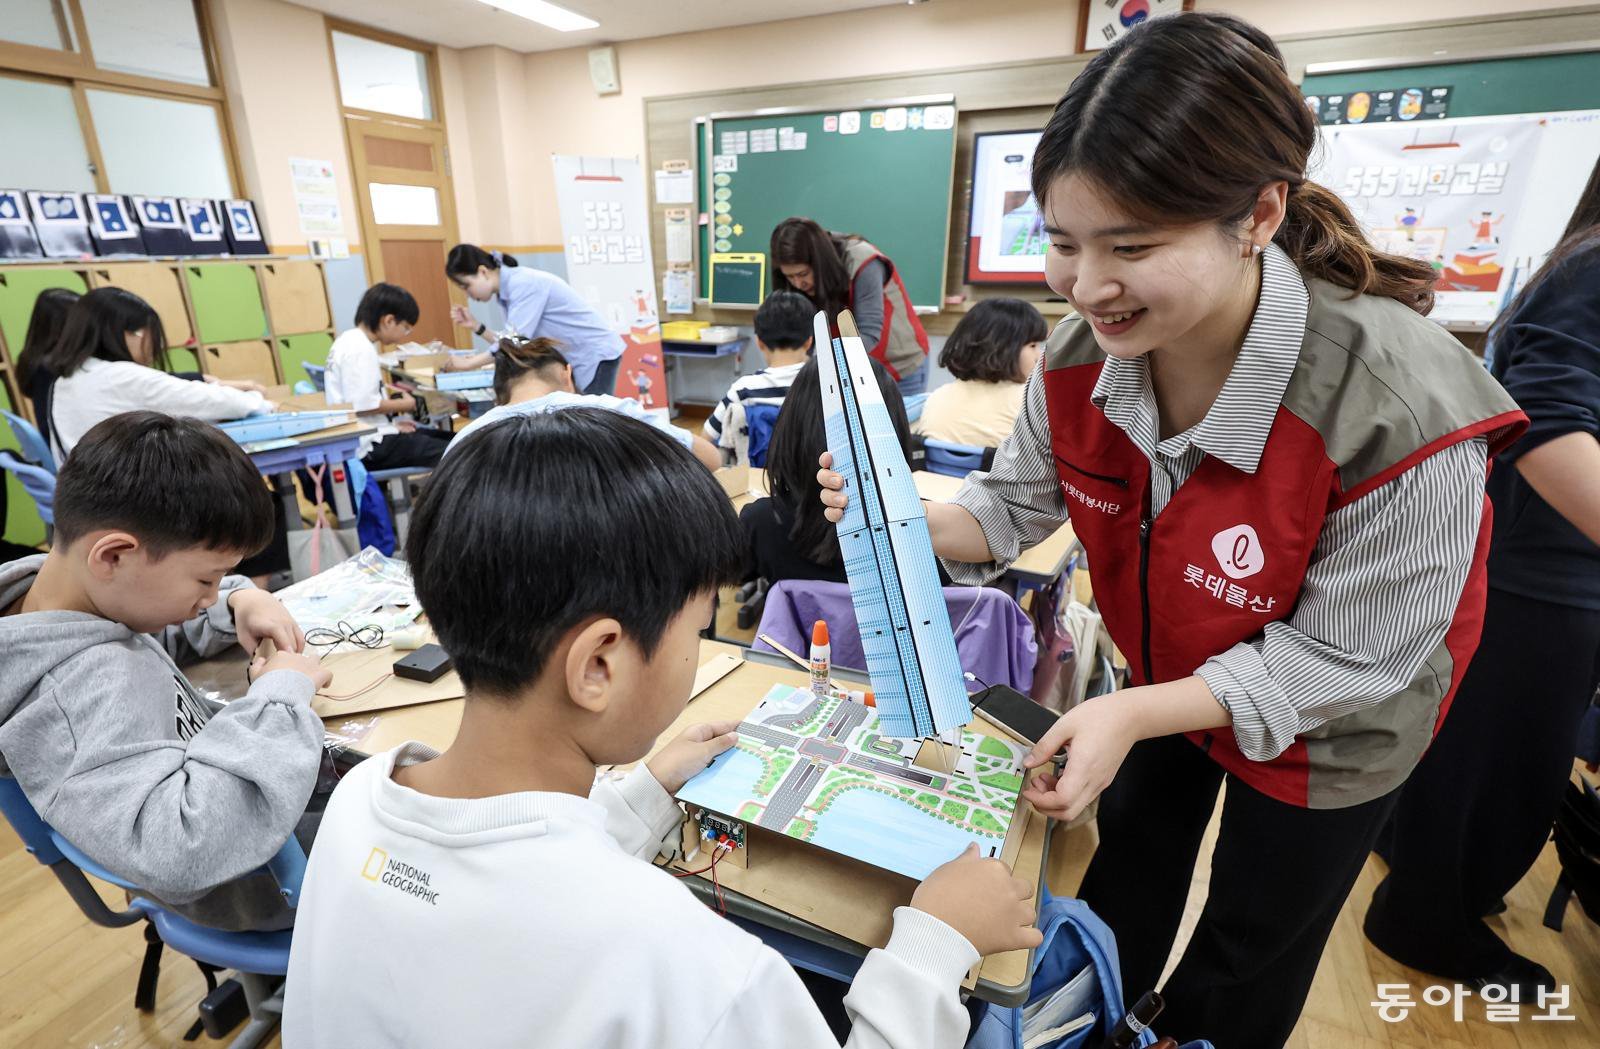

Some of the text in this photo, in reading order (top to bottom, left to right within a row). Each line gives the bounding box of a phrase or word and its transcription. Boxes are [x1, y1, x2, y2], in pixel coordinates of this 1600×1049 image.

[1344, 166, 1398, 198] 555
[582, 200, 625, 232] 555
[1183, 563, 1276, 613] 롯데물산
[381, 871, 440, 906] GEOGRAPHIC
[387, 858, 432, 887] NATIONAL
